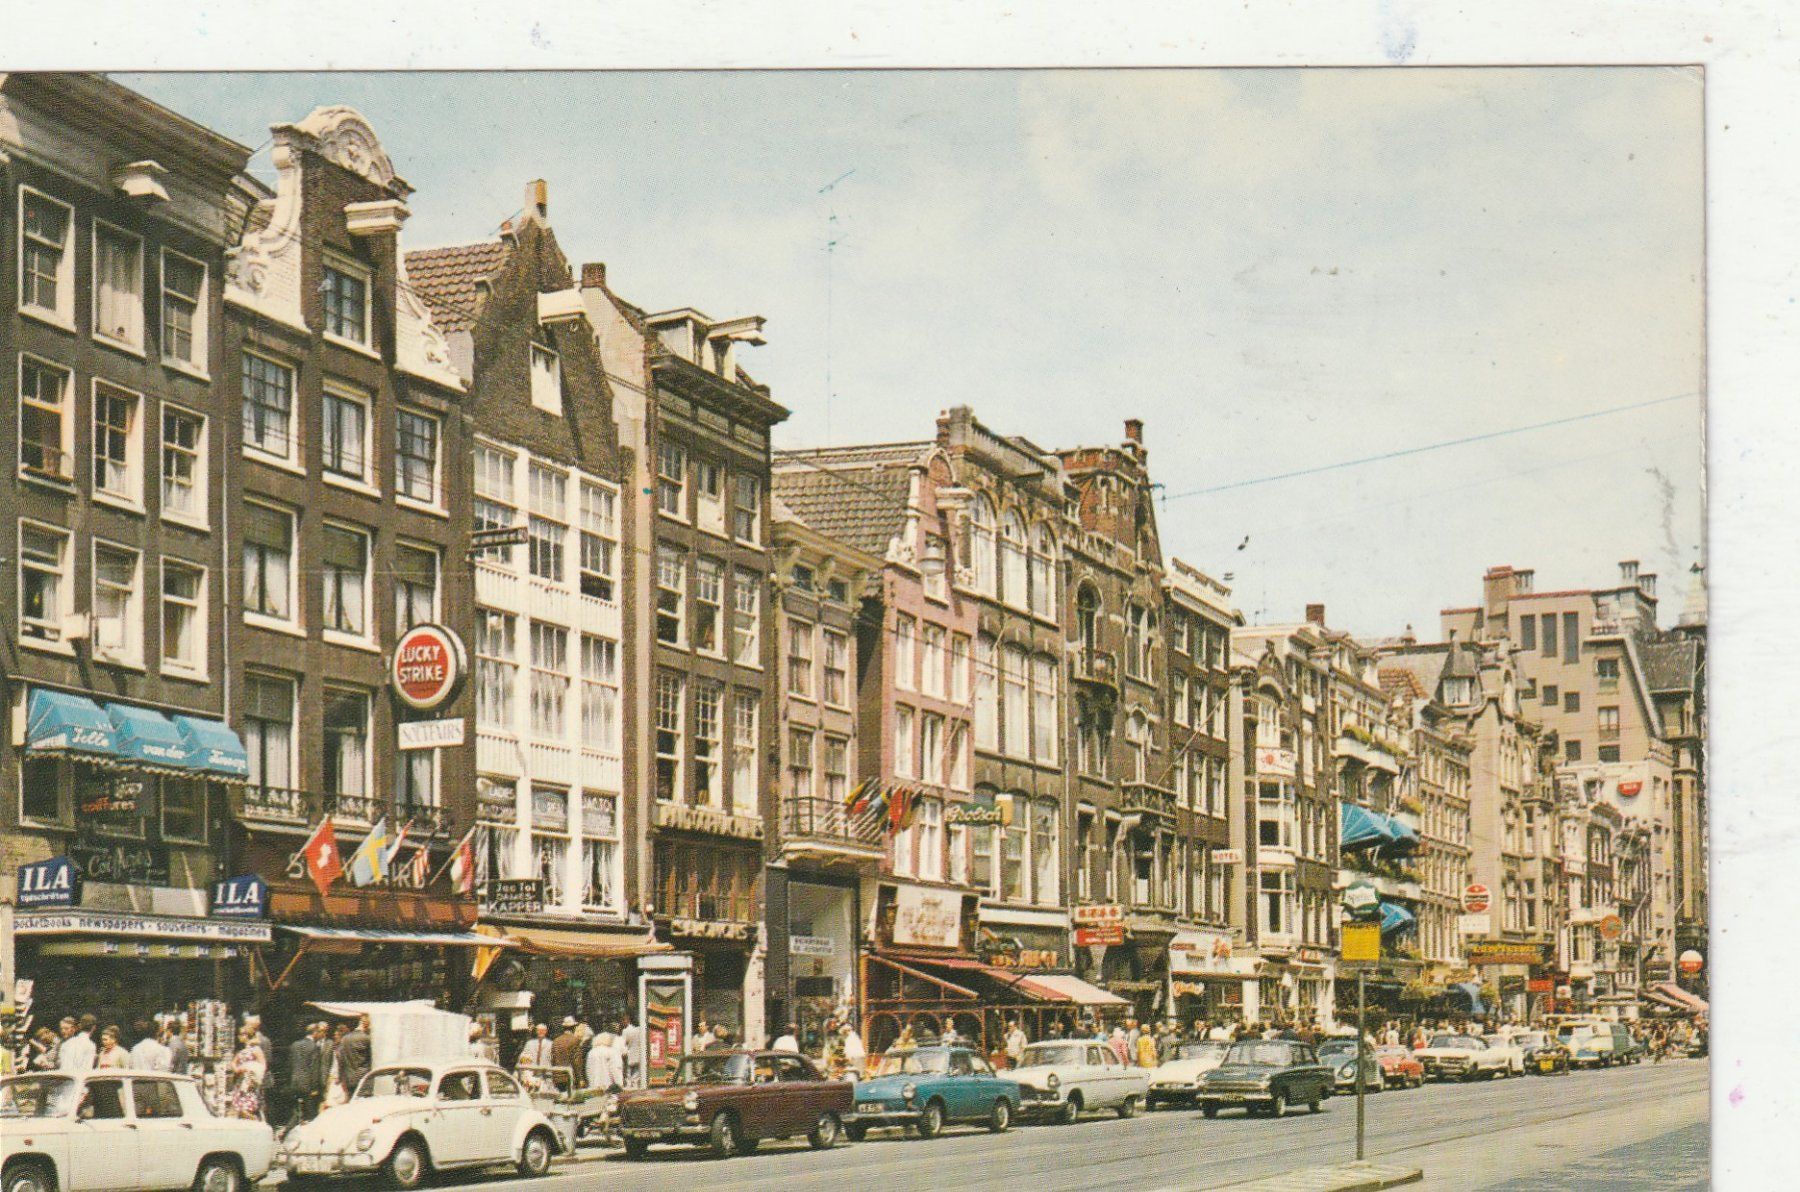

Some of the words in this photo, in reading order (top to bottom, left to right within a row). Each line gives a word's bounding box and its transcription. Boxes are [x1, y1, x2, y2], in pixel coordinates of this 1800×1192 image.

[401, 644, 441, 663] LUCKY
[399, 664, 444, 683] STRIKE
[22, 864, 70, 891] ILA
[213, 881, 261, 905] ILA
[79, 918, 144, 931] newspapers
[156, 922, 206, 933] souvenirs
